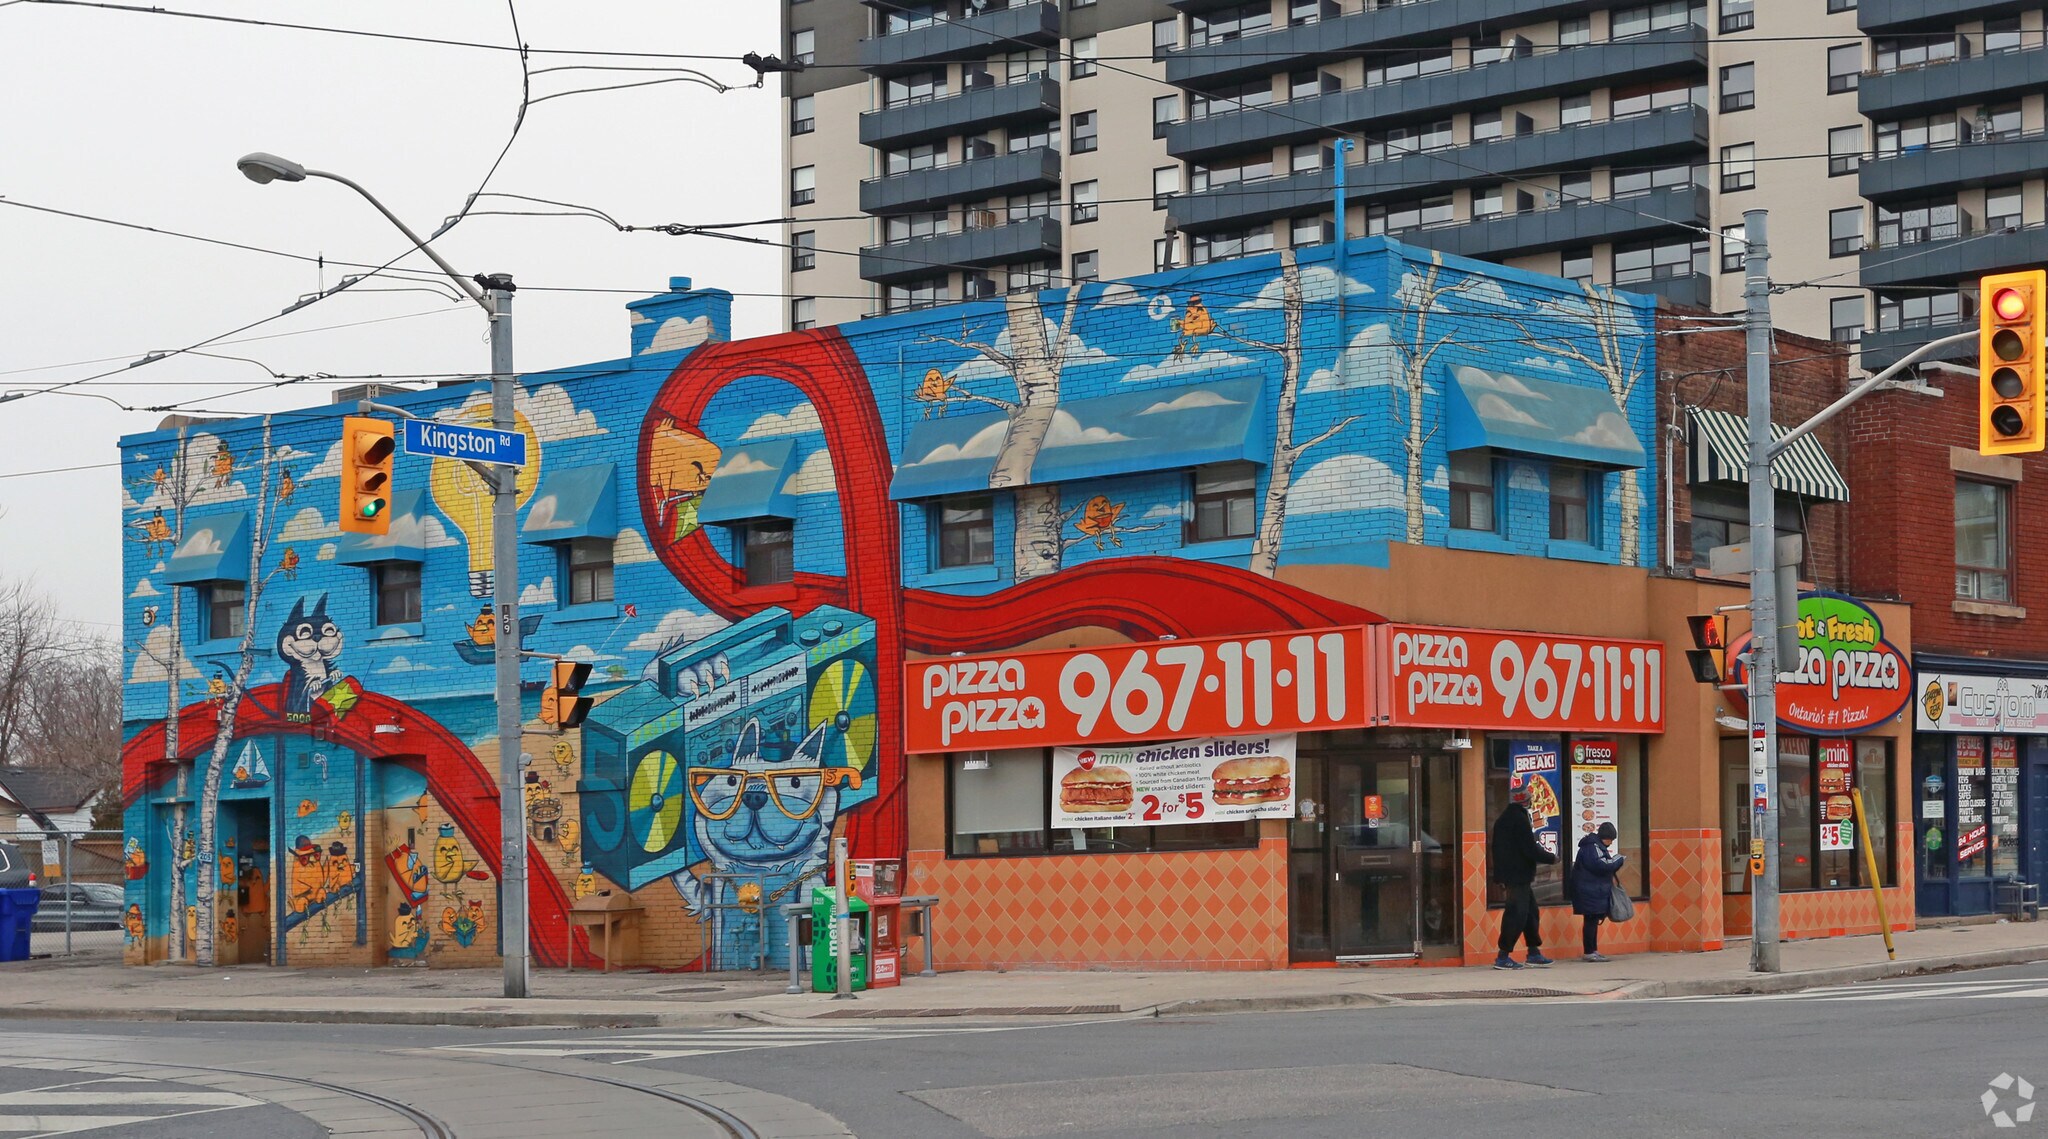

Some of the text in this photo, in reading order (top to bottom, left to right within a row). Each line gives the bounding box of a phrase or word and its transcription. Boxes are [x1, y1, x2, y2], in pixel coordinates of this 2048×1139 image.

[421, 424, 511, 456] Kingston Rd
[1826, 614, 1876, 645] Fresh
[1393, 632, 1468, 677] pizza
[923, 659, 1026, 710] pizza
[1832, 649, 1899, 700] pizza
[1408, 671, 1483, 716] pizza
[941, 696, 1046, 747] pizza
[1789, 703, 1869, 725] Ontario's #1 Pizza!
[1100, 751, 1134, 764] mini
[1136, 746, 1200, 763] chicken
[1204, 738, 1270, 758] sliders!
[1515, 754, 1555, 772] BREAK!
[1585, 745, 1612, 758] fresco
[1827, 744, 1849, 762] mini
[1141, 792, 1205, 821] 2 for $5
[1822, 826, 1828, 839] 2
[1958, 825, 1986, 847] 24 HOUR
[1960, 840, 1985, 859] SERVICE
